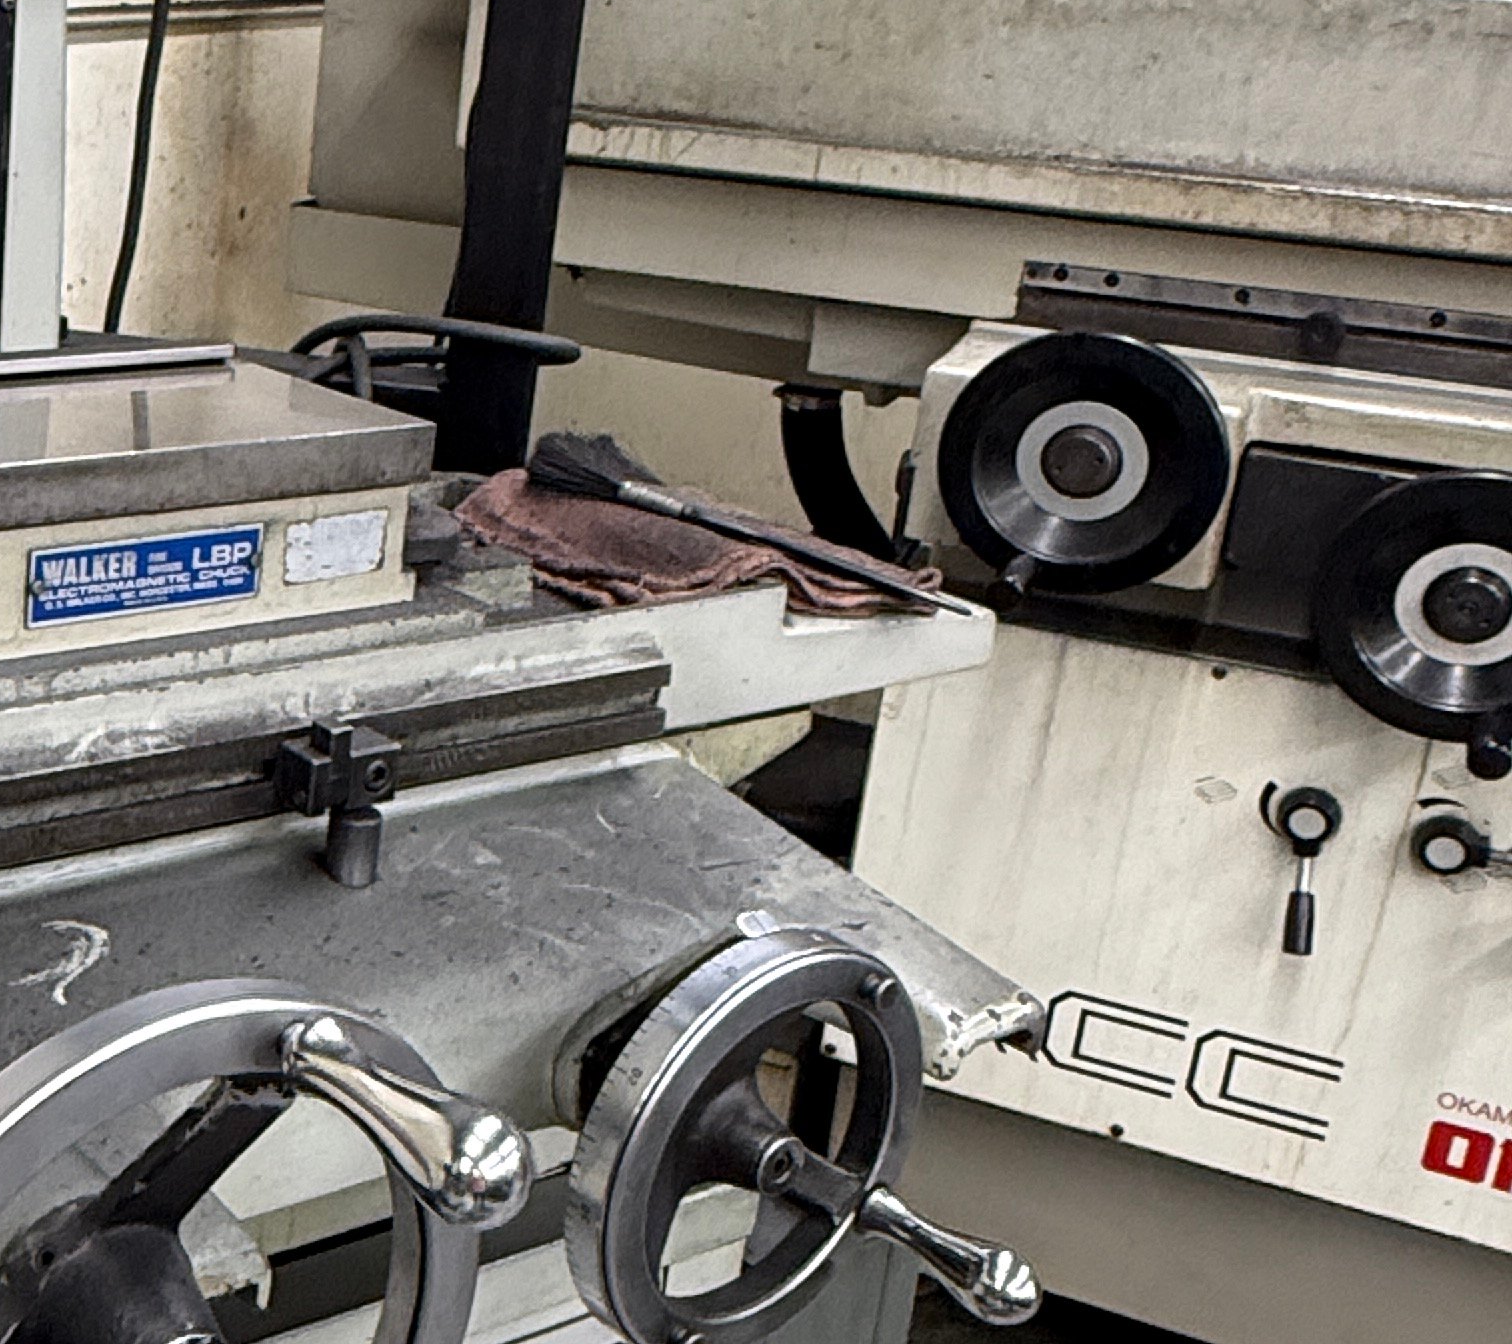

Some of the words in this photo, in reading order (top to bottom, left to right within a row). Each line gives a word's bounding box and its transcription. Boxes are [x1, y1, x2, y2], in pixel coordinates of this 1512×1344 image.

[42, 551, 137, 587] WALKER
[192, 541, 252, 570] LBP
[39, 572, 191, 601] ELECTROMAGNETIC
[198, 565, 250, 580] CHUCK
[1436, 1092, 1512, 1126] OKAM
